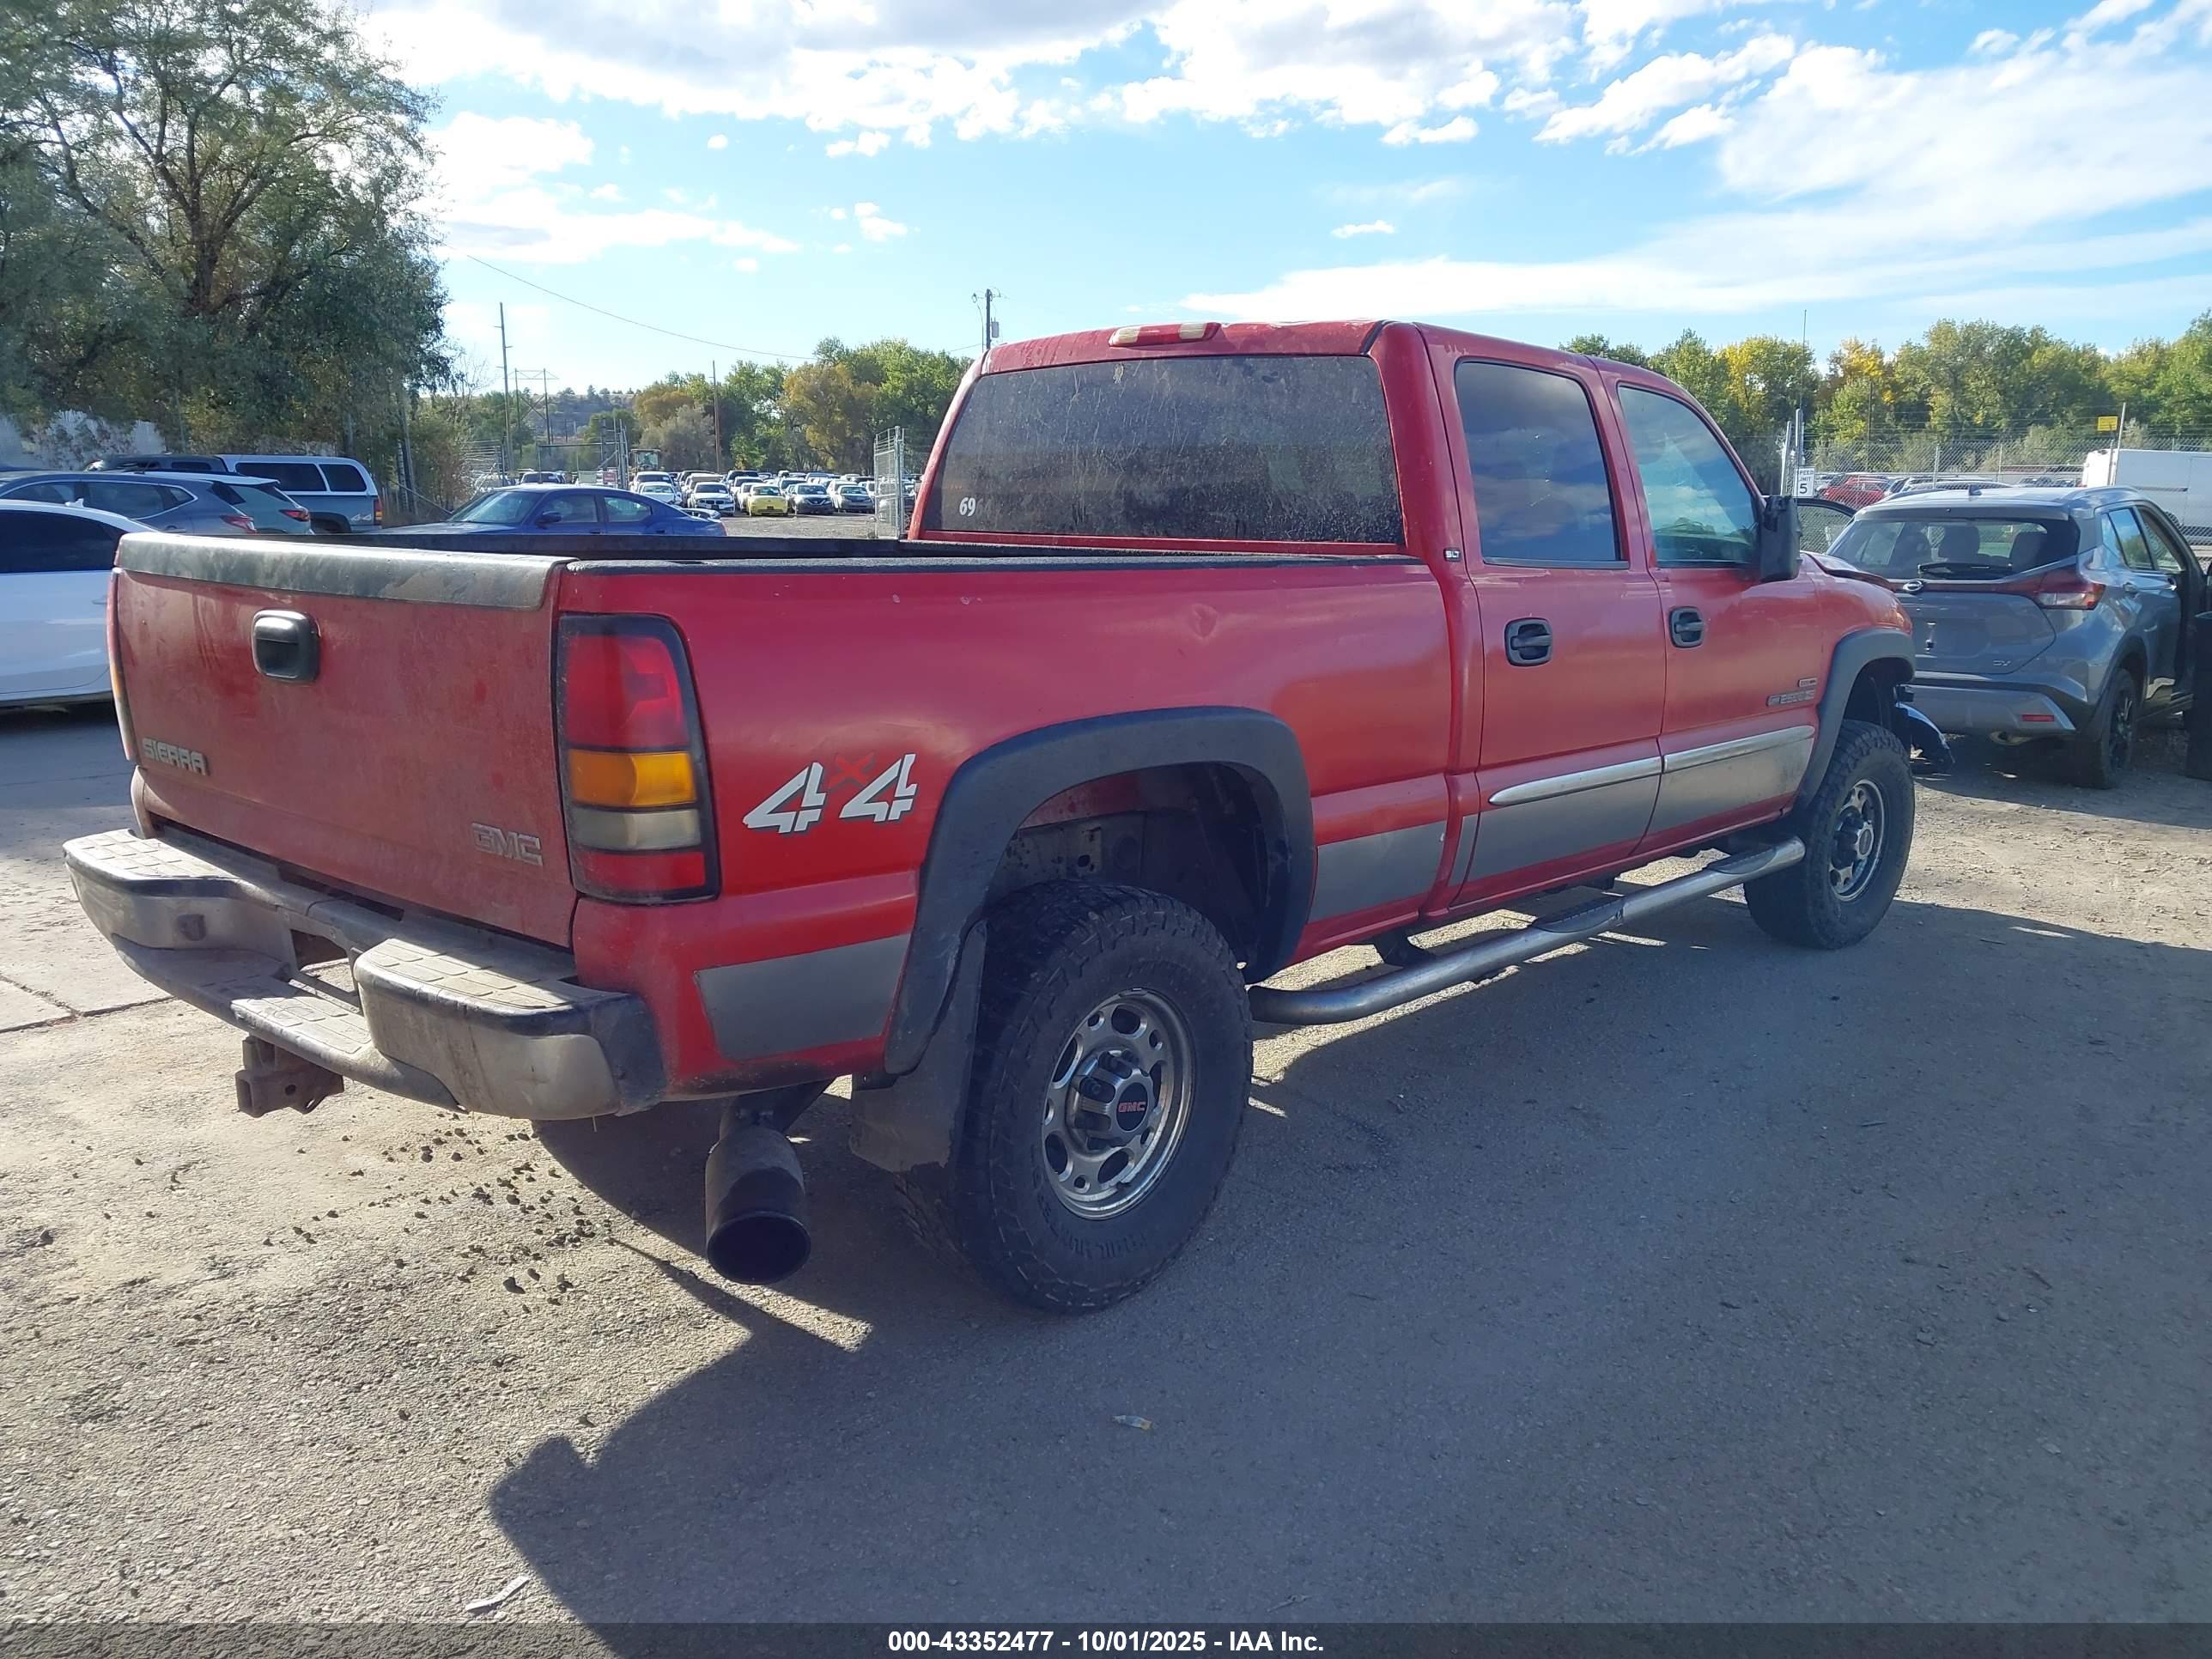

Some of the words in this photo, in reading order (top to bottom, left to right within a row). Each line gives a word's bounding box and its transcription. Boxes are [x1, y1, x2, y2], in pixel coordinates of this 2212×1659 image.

[1799, 483, 1808, 495] 5
[959, 496, 976, 517] 69
[142, 737, 209, 776] SIERRA
[471, 822, 544, 866] GMC
[1118, 1101, 1146, 1113] GMC
